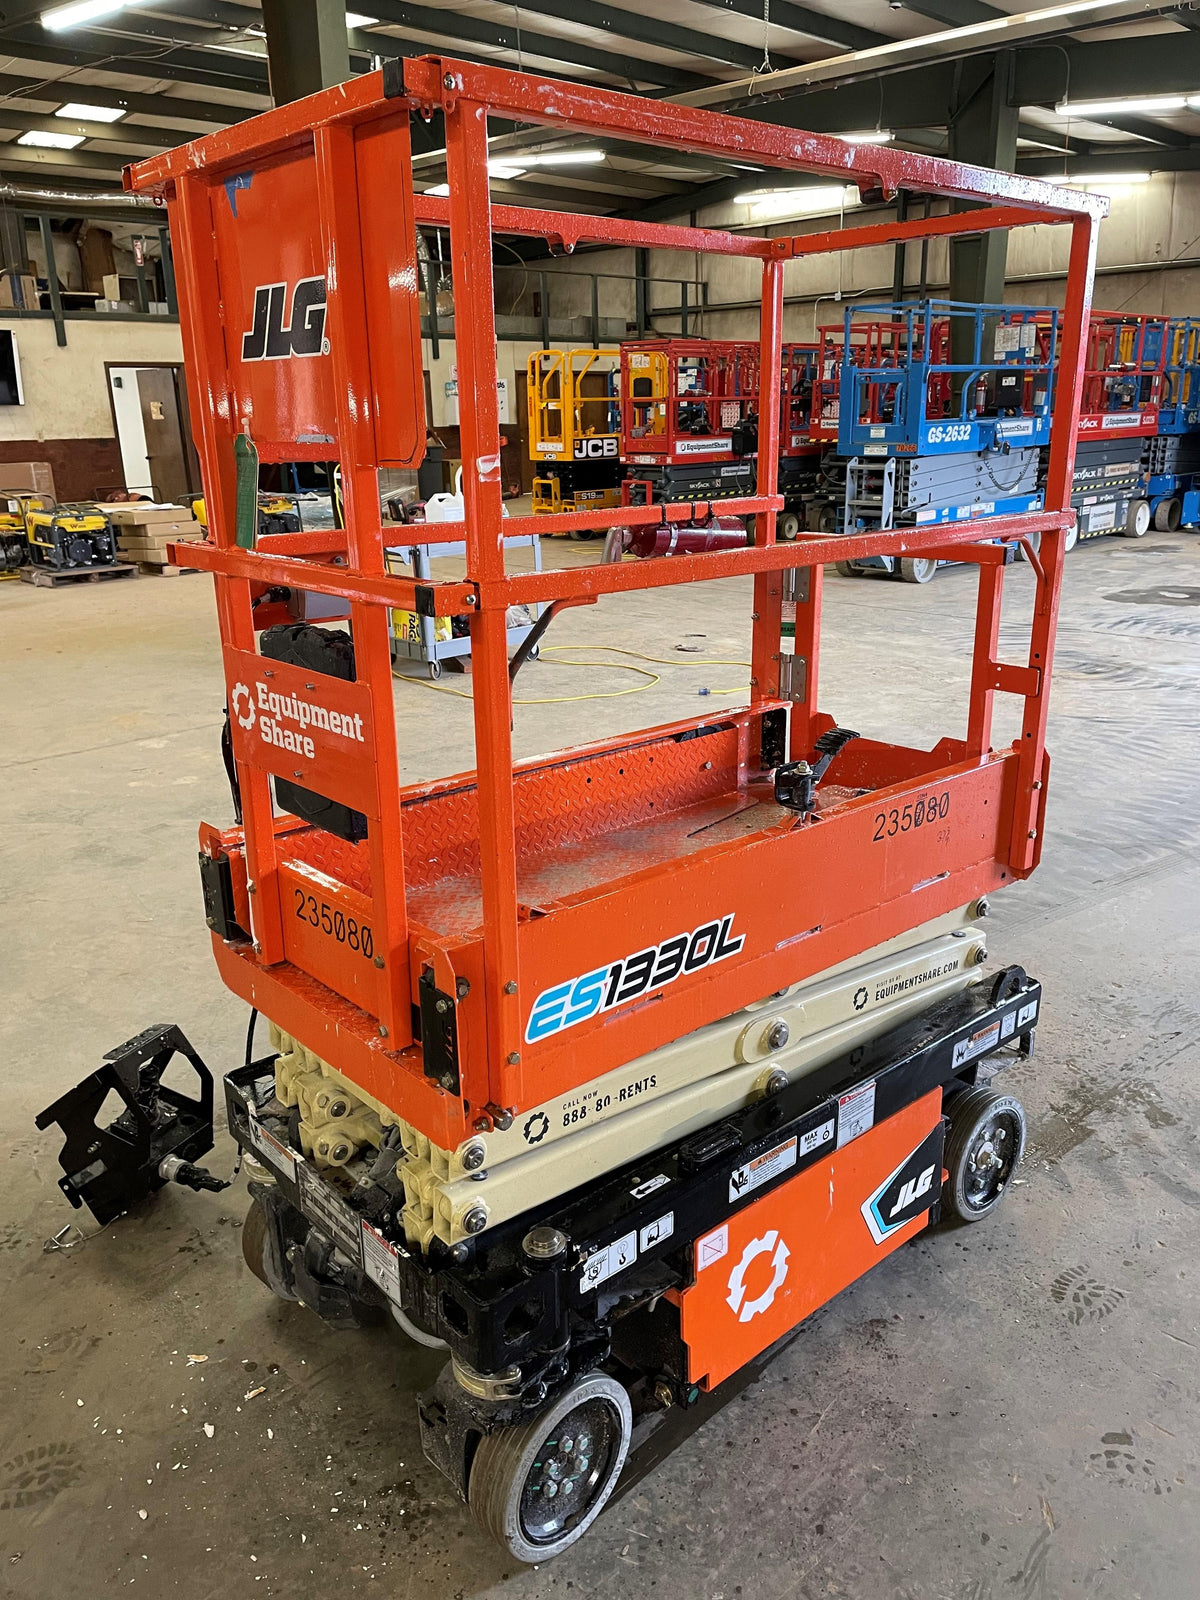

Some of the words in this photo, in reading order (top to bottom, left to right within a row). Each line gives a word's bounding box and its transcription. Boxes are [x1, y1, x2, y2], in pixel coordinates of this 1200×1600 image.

[242, 276, 328, 361] JLG
[575, 439, 618, 458] JCB
[686, 442, 728, 452] EquipmentShare
[928, 424, 972, 444] GS-2632
[256, 681, 365, 742] Equipment
[260, 715, 315, 759] Share
[873, 791, 950, 842] 235080
[295, 889, 374, 959] 235080
[526, 913, 745, 1043] ES1330L
[875, 960, 959, 1001] EQUIPMENTSHARE.COM
[562, 1098, 580, 1110] CALL
[582, 1090, 598, 1102] NOW
[804, 1131, 818, 1143] MAX
[889, 1164, 936, 1218] JLG
